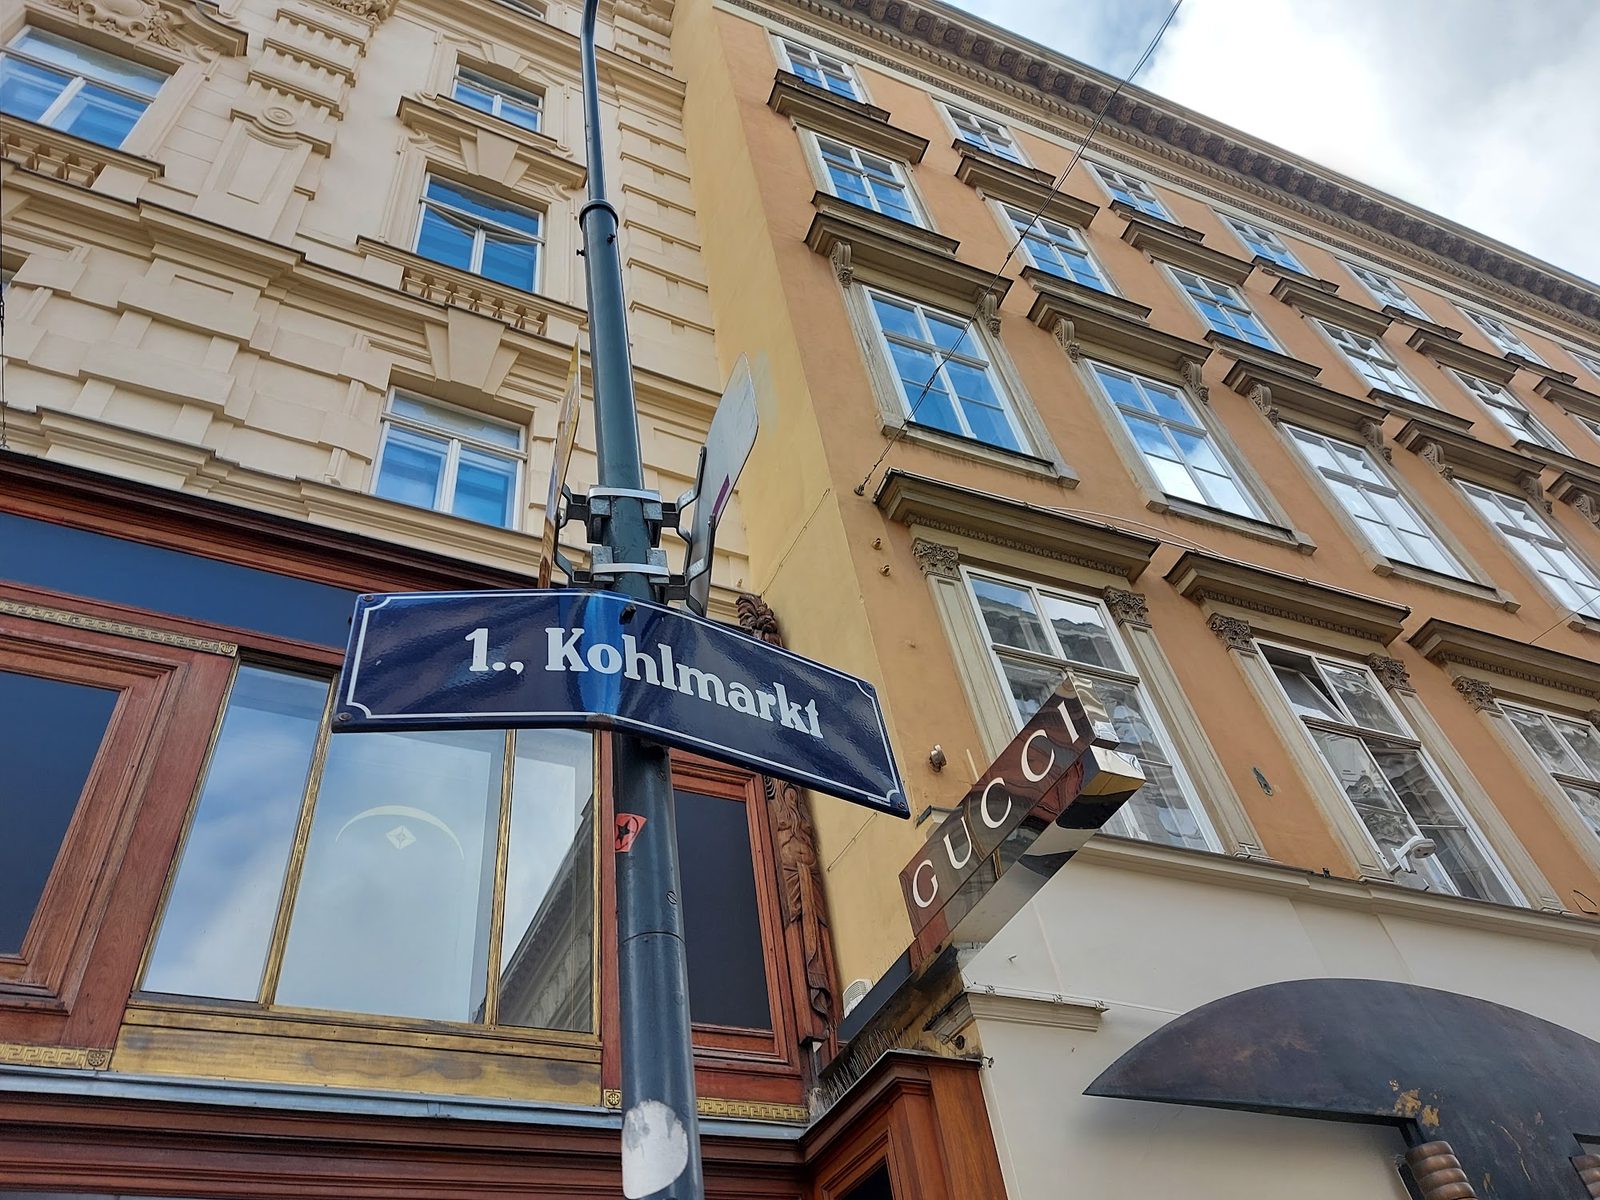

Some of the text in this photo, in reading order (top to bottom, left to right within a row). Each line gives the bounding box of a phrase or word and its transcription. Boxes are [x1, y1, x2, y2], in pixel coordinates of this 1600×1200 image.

[465, 627, 823, 739] 1., Kohlmarkt
[912, 701, 1080, 908] GUCCI
